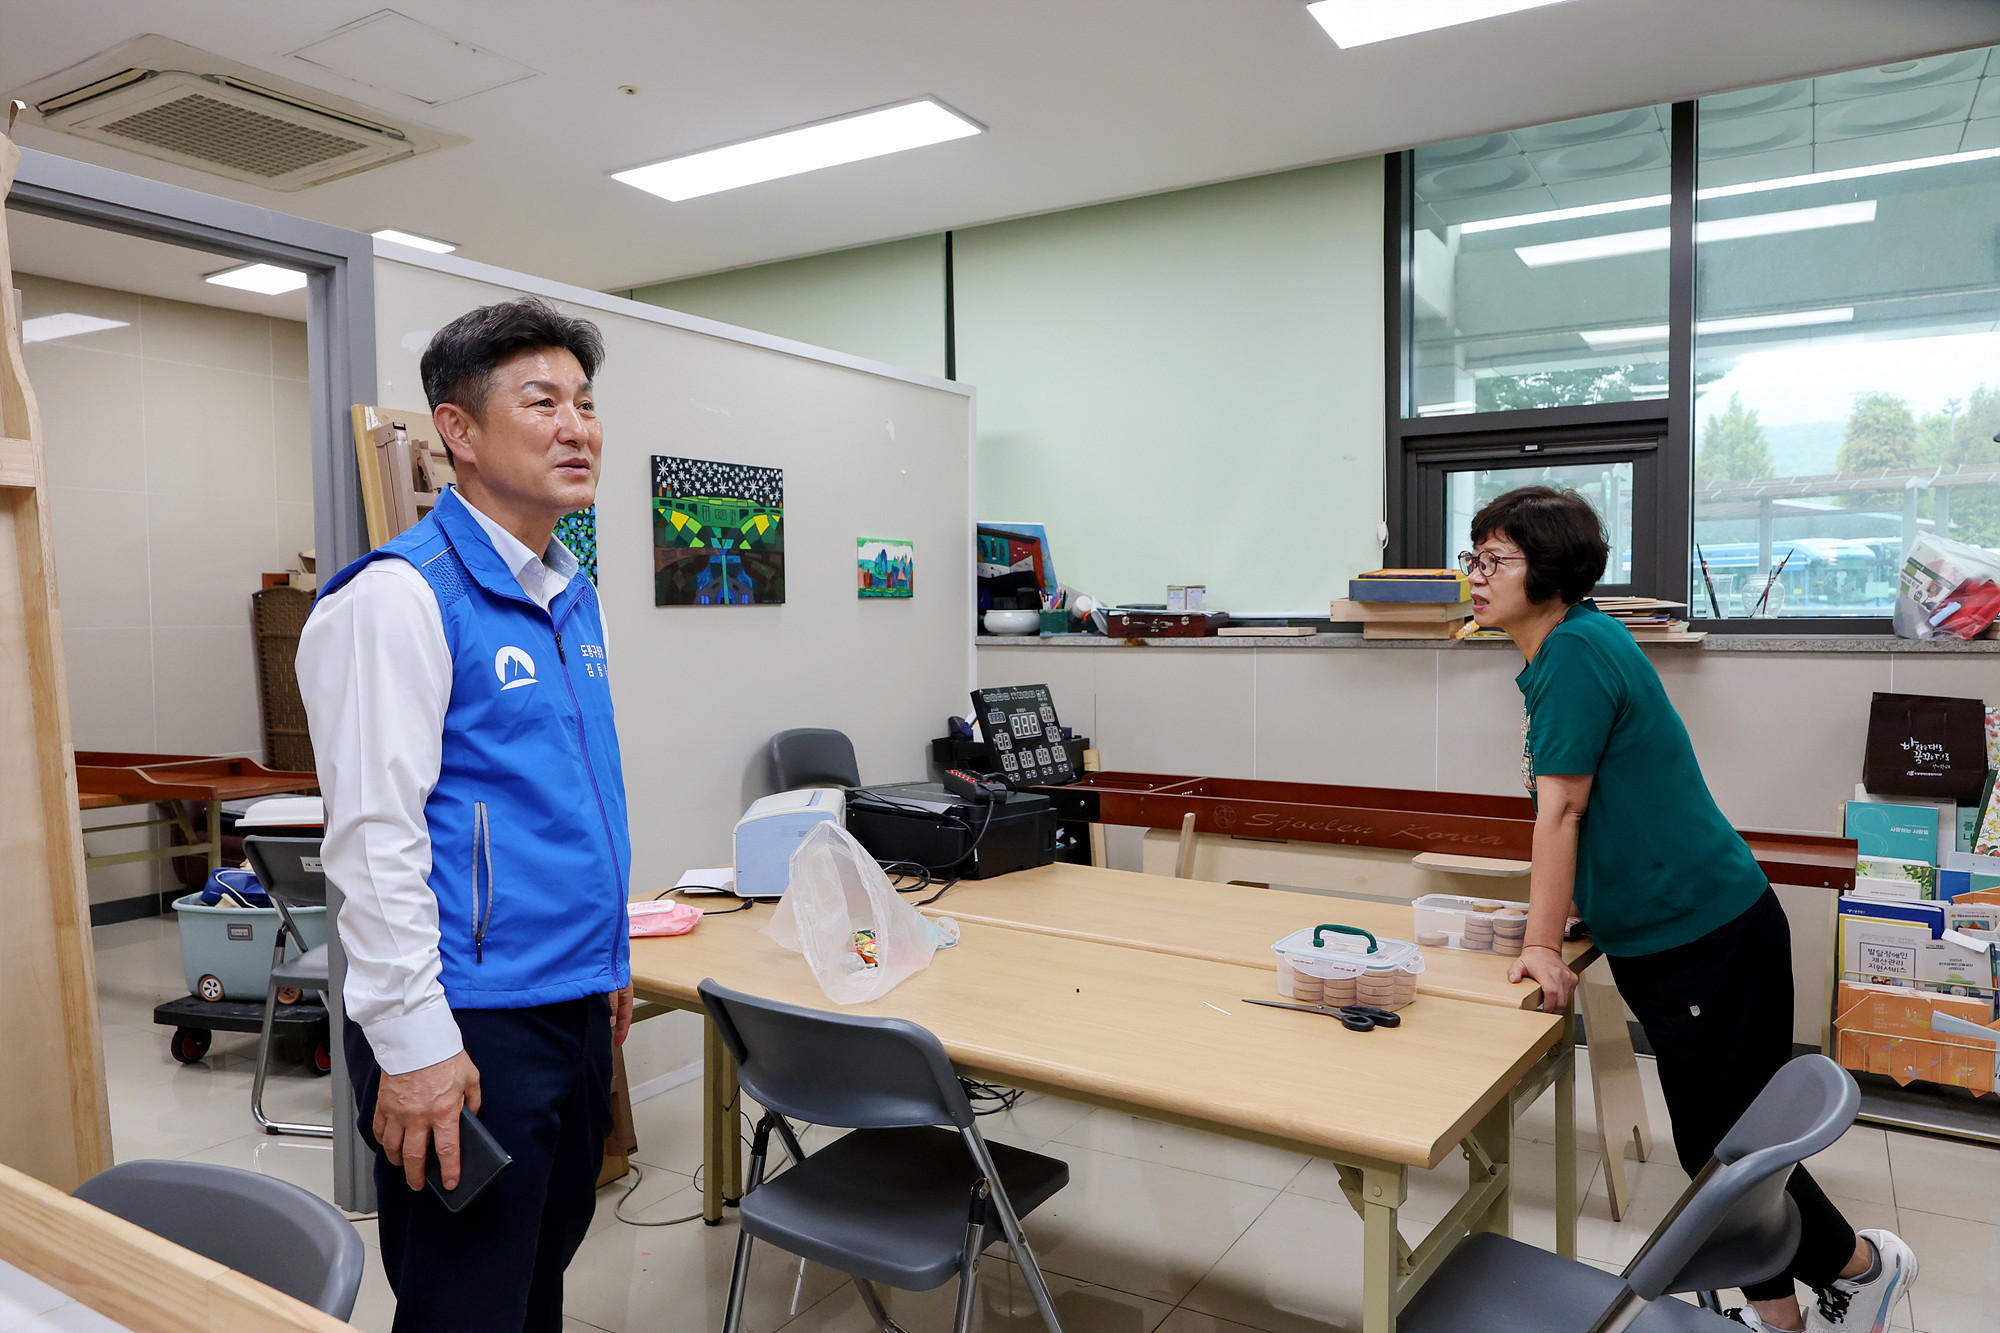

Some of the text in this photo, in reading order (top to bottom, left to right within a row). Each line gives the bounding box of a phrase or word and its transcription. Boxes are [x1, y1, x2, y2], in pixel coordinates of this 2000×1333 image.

[1245, 813, 1507, 846] Sjoelen Korea
[1867, 948, 1908, 960] 발달장애인
[1871, 957, 1904, 966] 재산관리
[1868, 963, 1908, 973] 지원서비스
